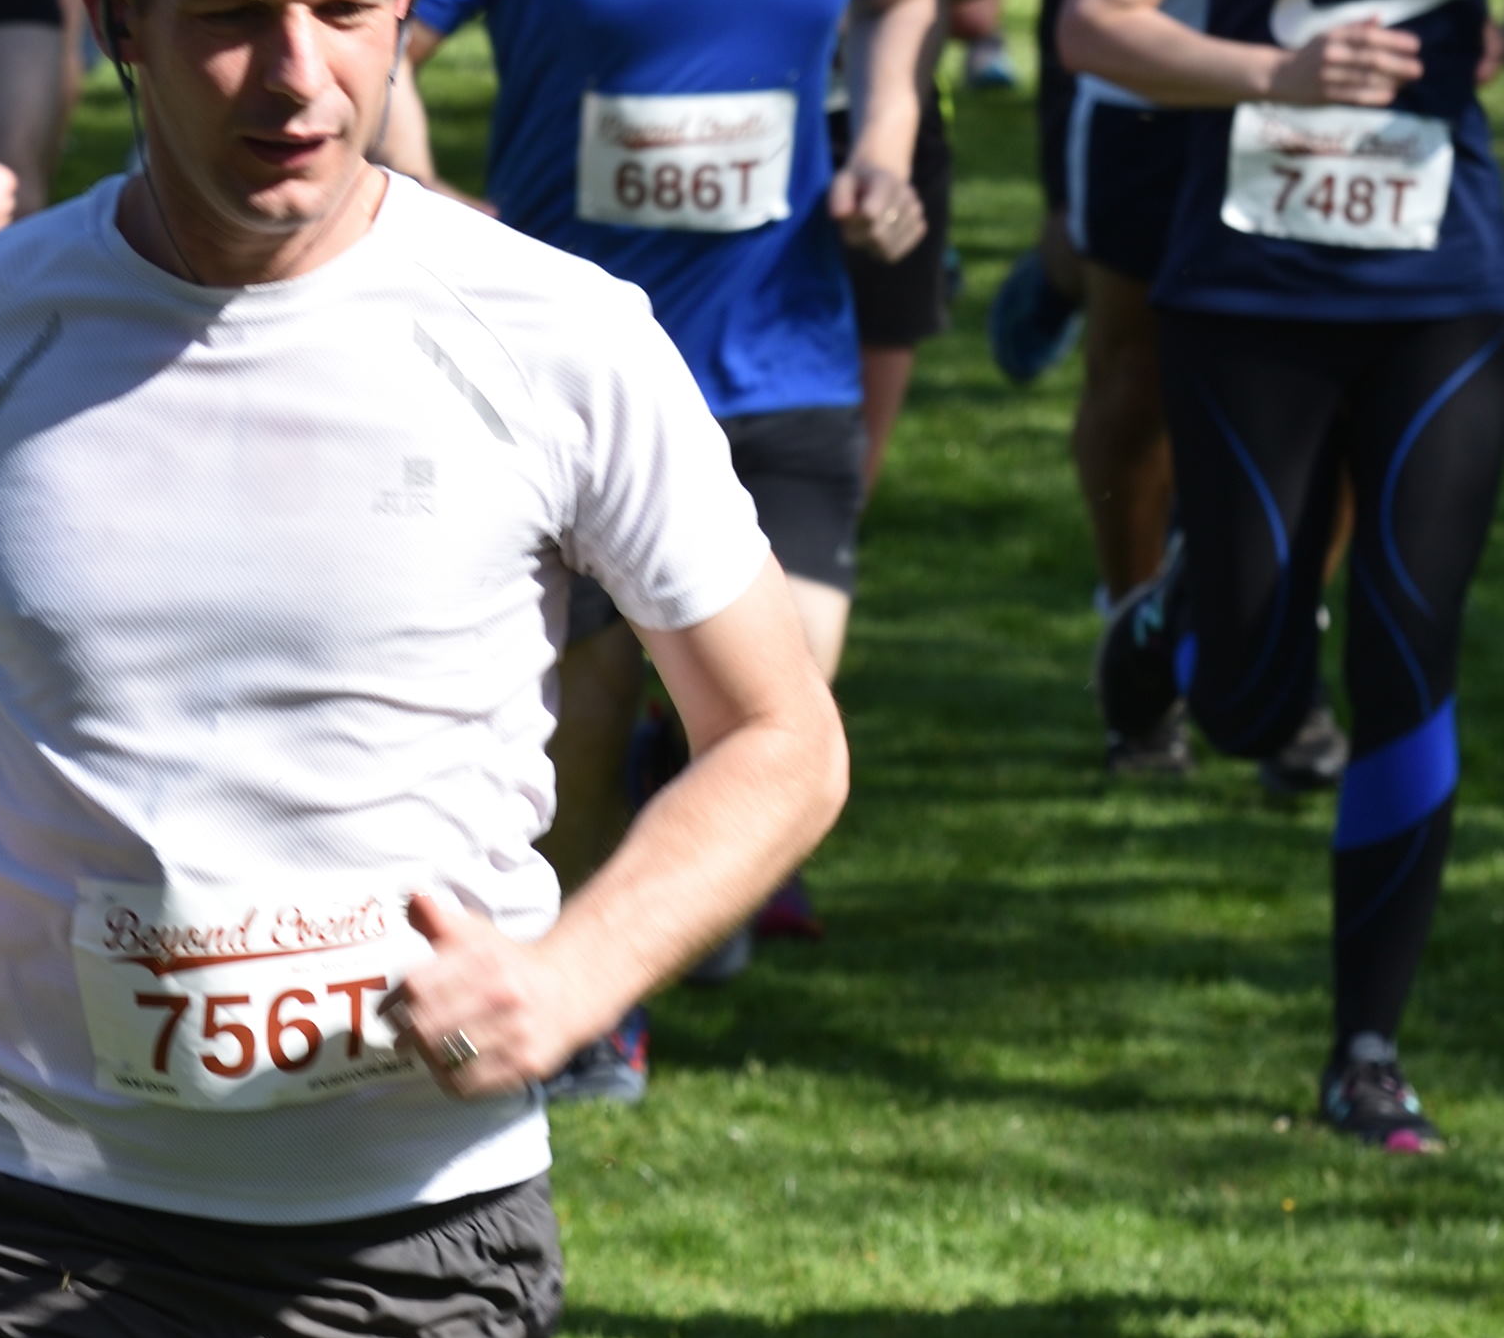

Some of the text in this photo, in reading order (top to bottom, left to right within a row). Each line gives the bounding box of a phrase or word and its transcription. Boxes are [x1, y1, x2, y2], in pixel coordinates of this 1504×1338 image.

[613, 159, 761, 212] 686T
[1270, 164, 1419, 227] 748T
[134, 976, 388, 1078] 756T
